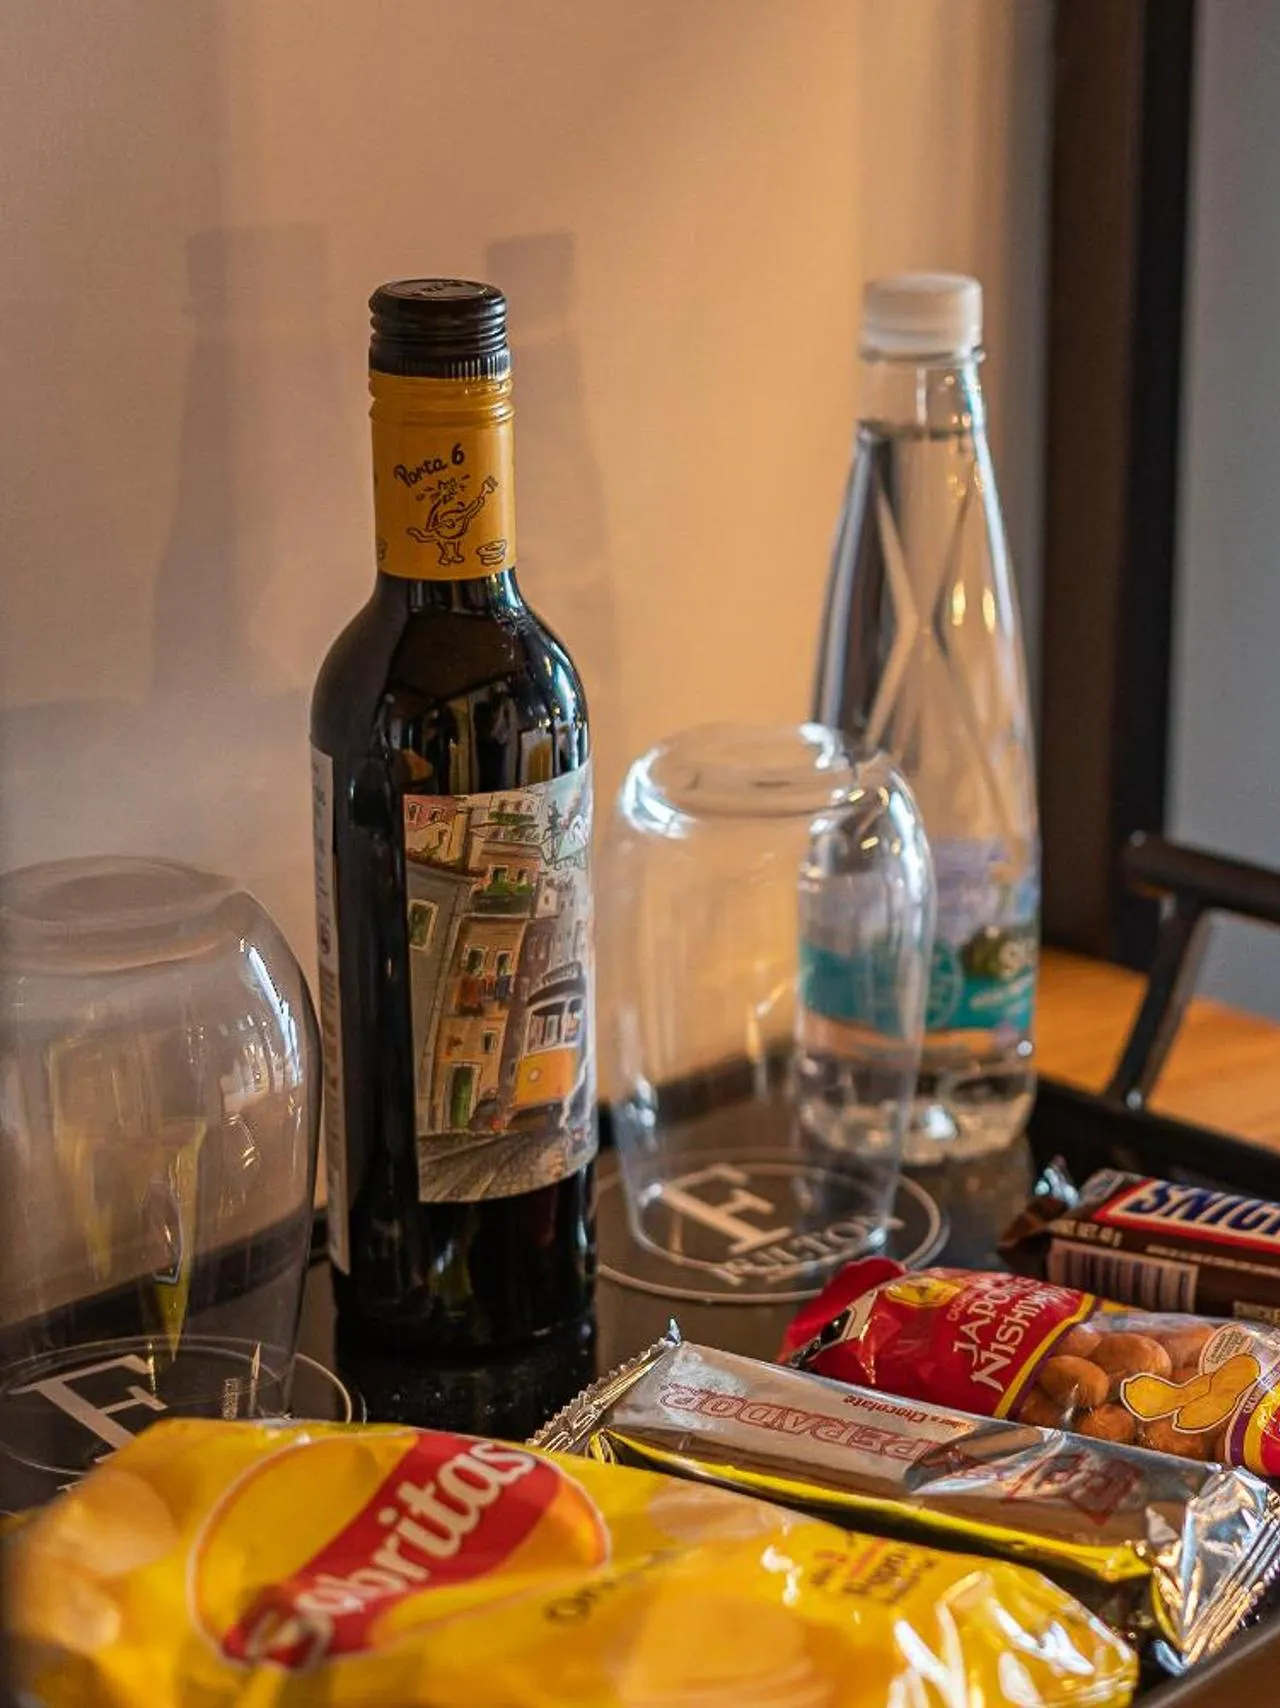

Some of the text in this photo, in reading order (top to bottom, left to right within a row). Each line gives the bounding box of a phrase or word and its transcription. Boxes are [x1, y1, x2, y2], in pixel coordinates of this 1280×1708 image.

[394, 443, 466, 488] Porta 6
[843, 1395, 927, 1424] Chocolate
